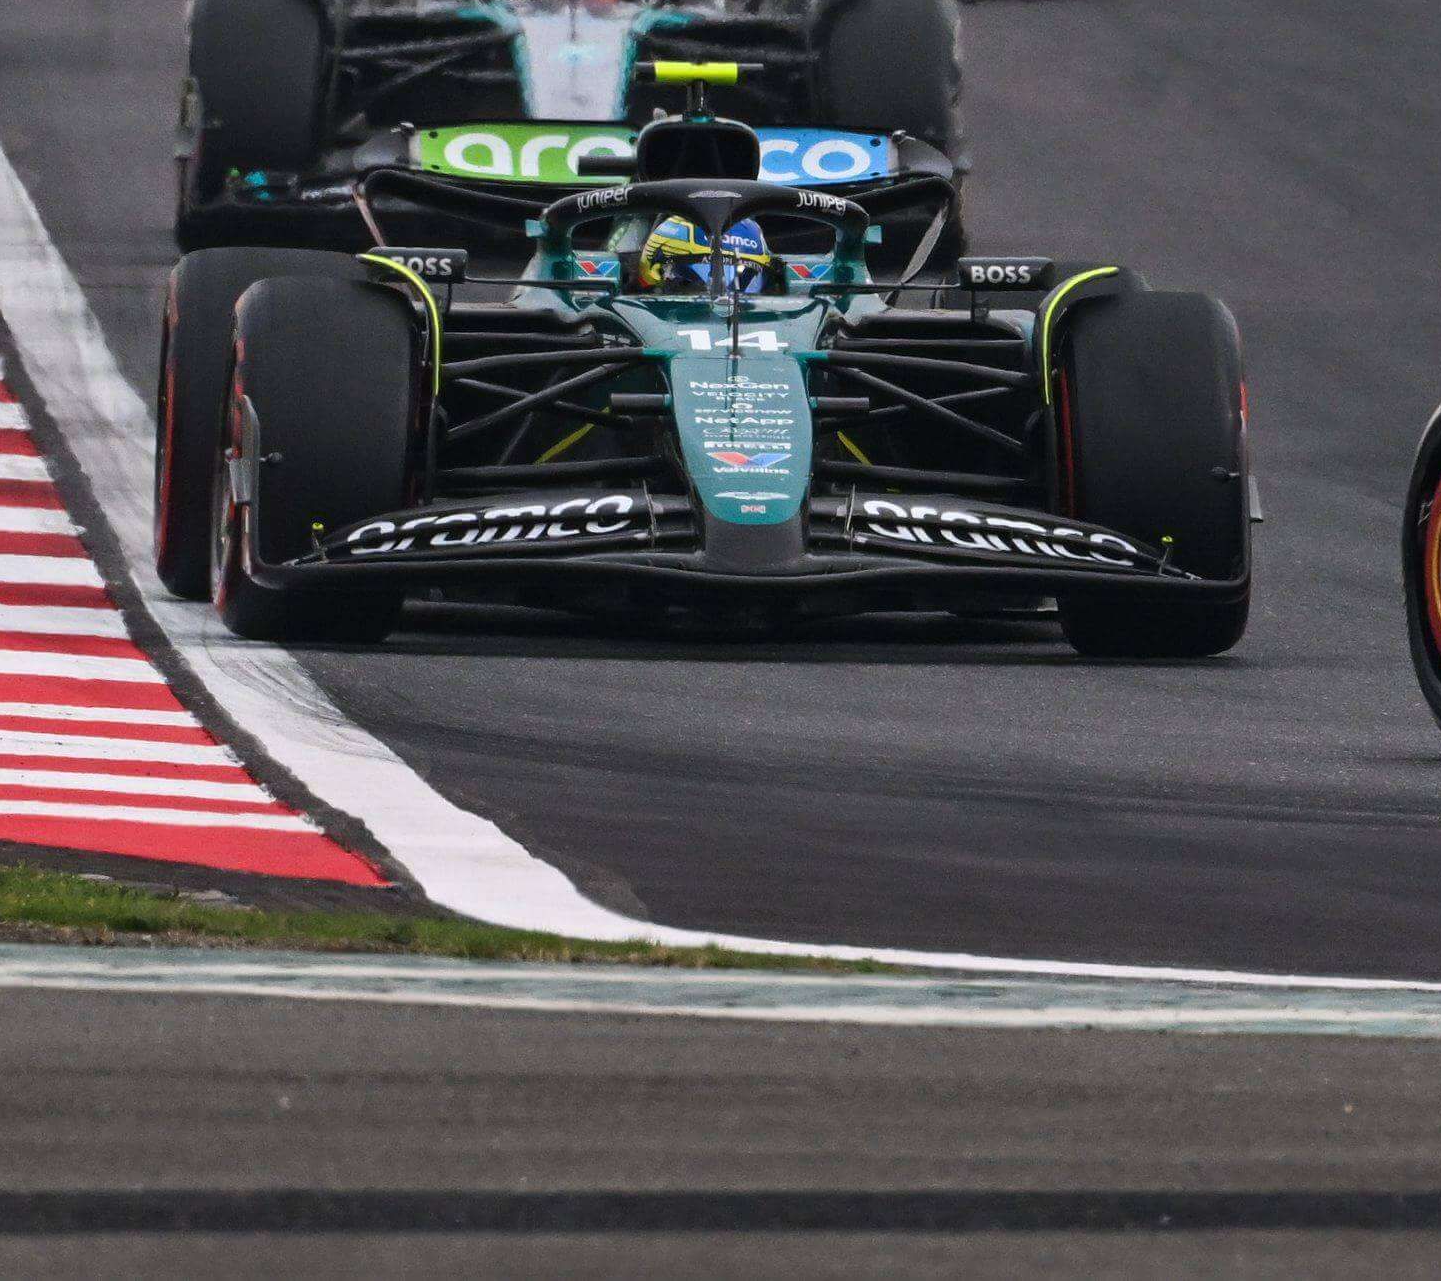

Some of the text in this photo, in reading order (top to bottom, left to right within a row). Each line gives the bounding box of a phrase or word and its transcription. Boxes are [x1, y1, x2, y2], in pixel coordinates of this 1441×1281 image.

[970, 265, 1032, 285] BOSS
[676, 329, 789, 351] 14
[695, 416, 794, 425] NetApp
[347, 494, 634, 555] aramco
[863, 499, 1139, 567] aramco
